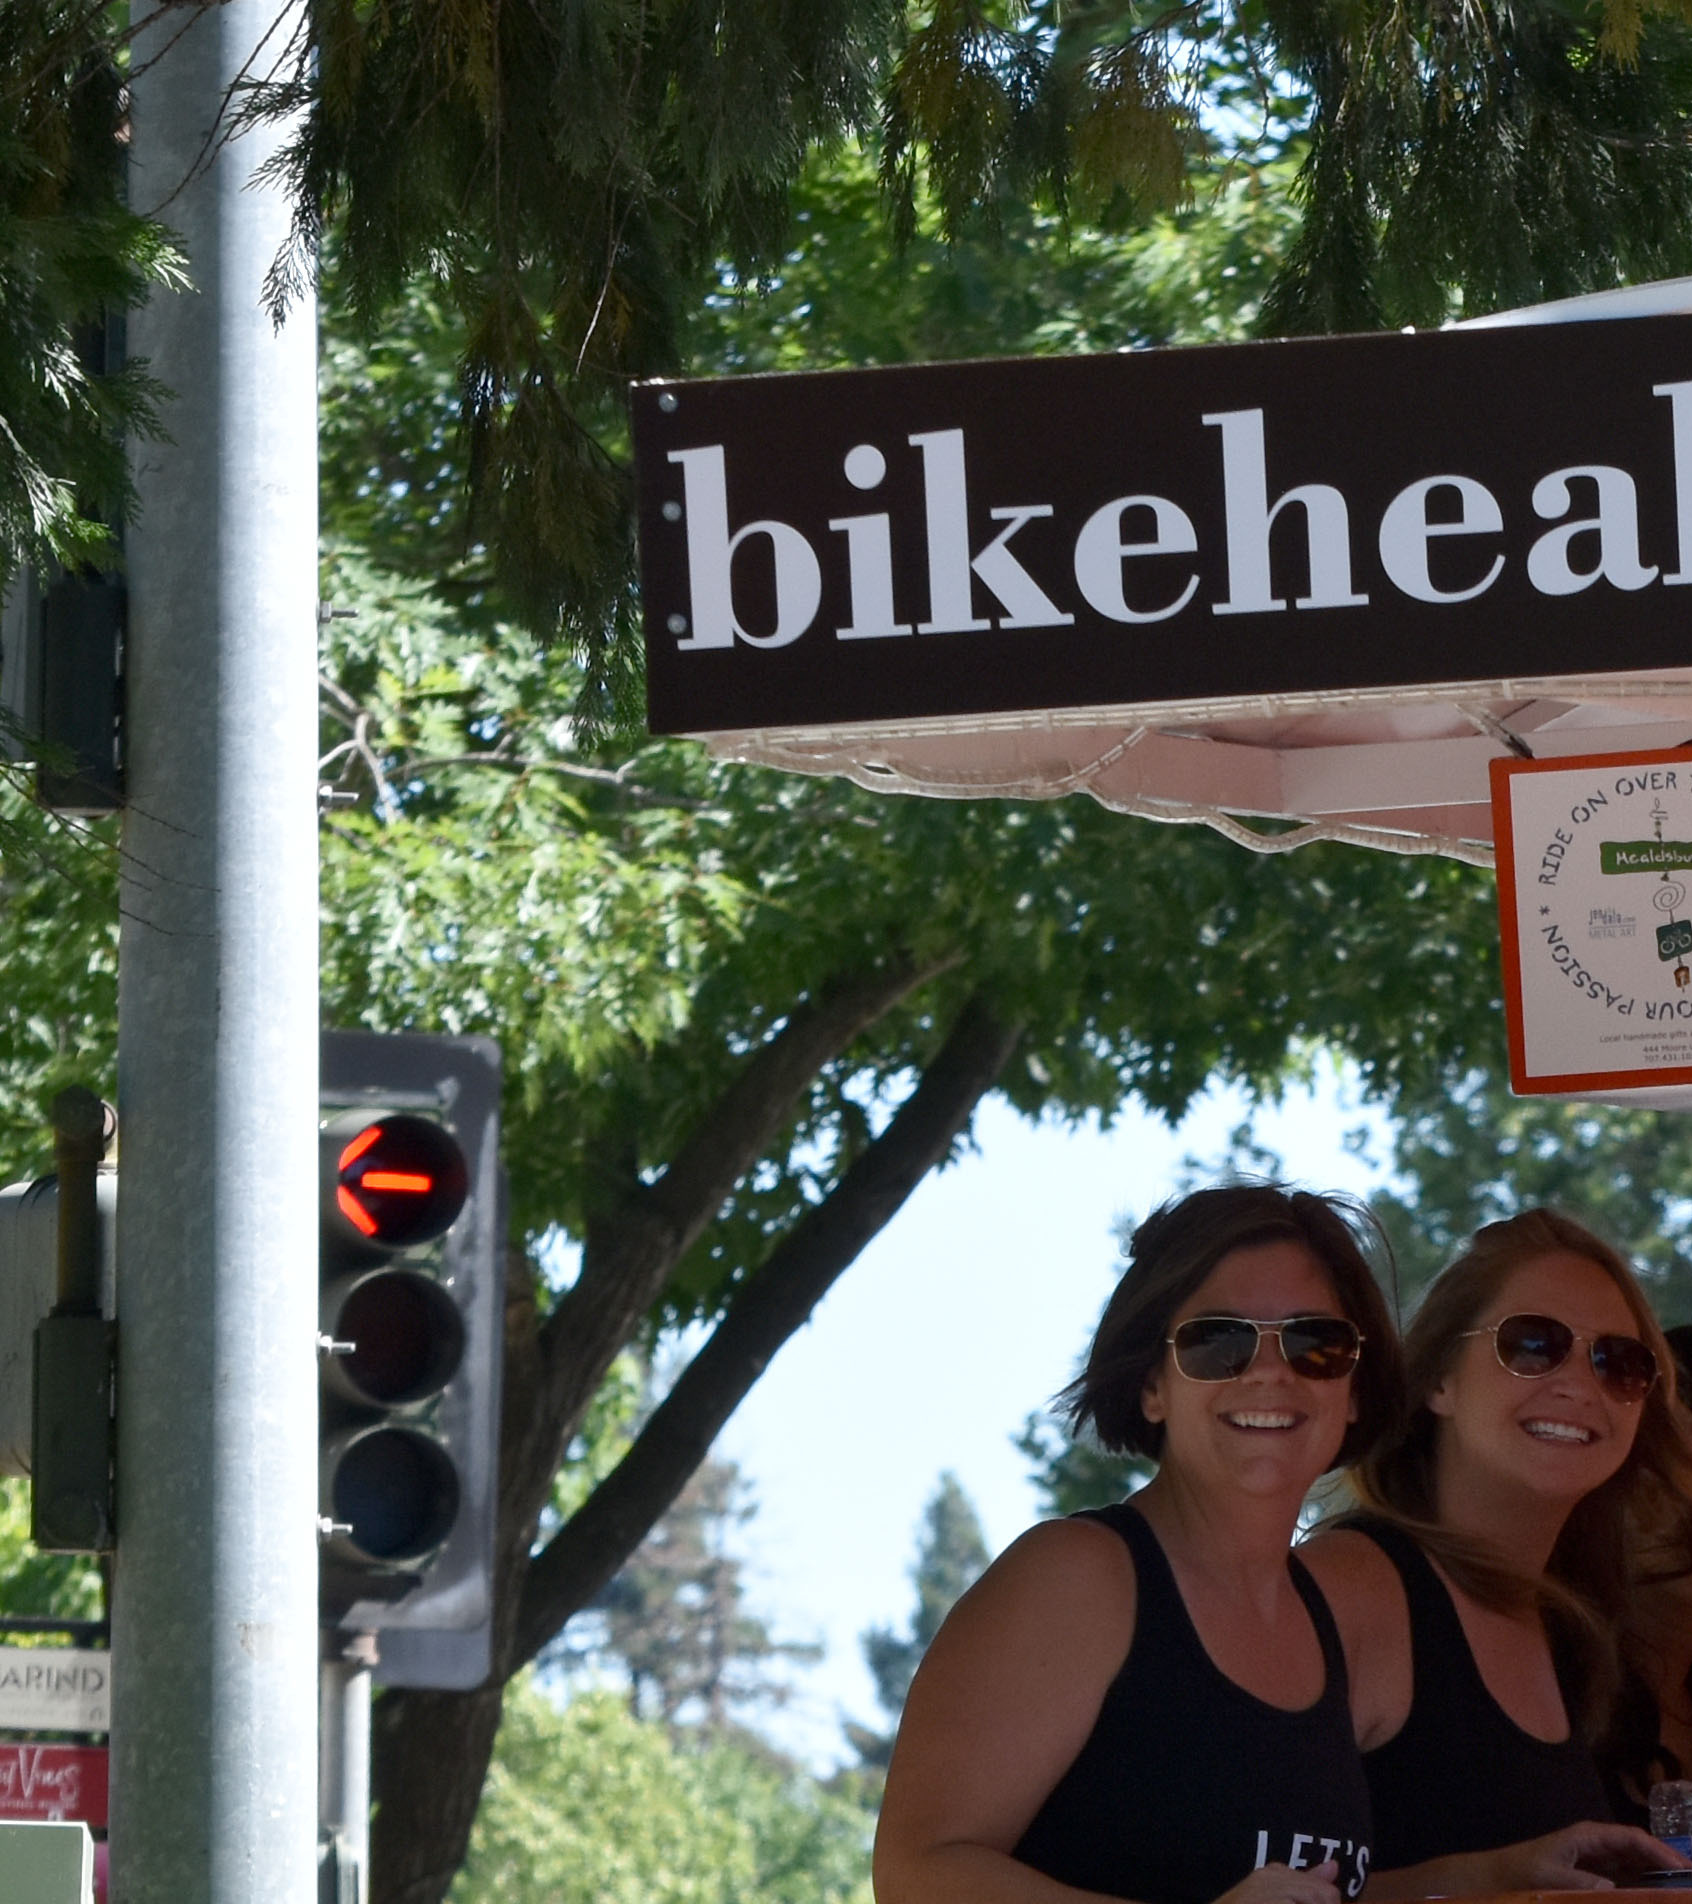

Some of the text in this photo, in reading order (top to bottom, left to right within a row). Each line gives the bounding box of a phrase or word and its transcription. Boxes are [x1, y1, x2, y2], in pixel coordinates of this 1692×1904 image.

[1538, 828, 1573, 885] RIDE
[1571, 791, 1608, 824] ON
[1615, 772, 1677, 796] OVER
[1541, 925, 1635, 1015] PASSION
[1623, 1032, 1667, 1042] handmade
[1669, 1030, 1687, 1040] gifts
